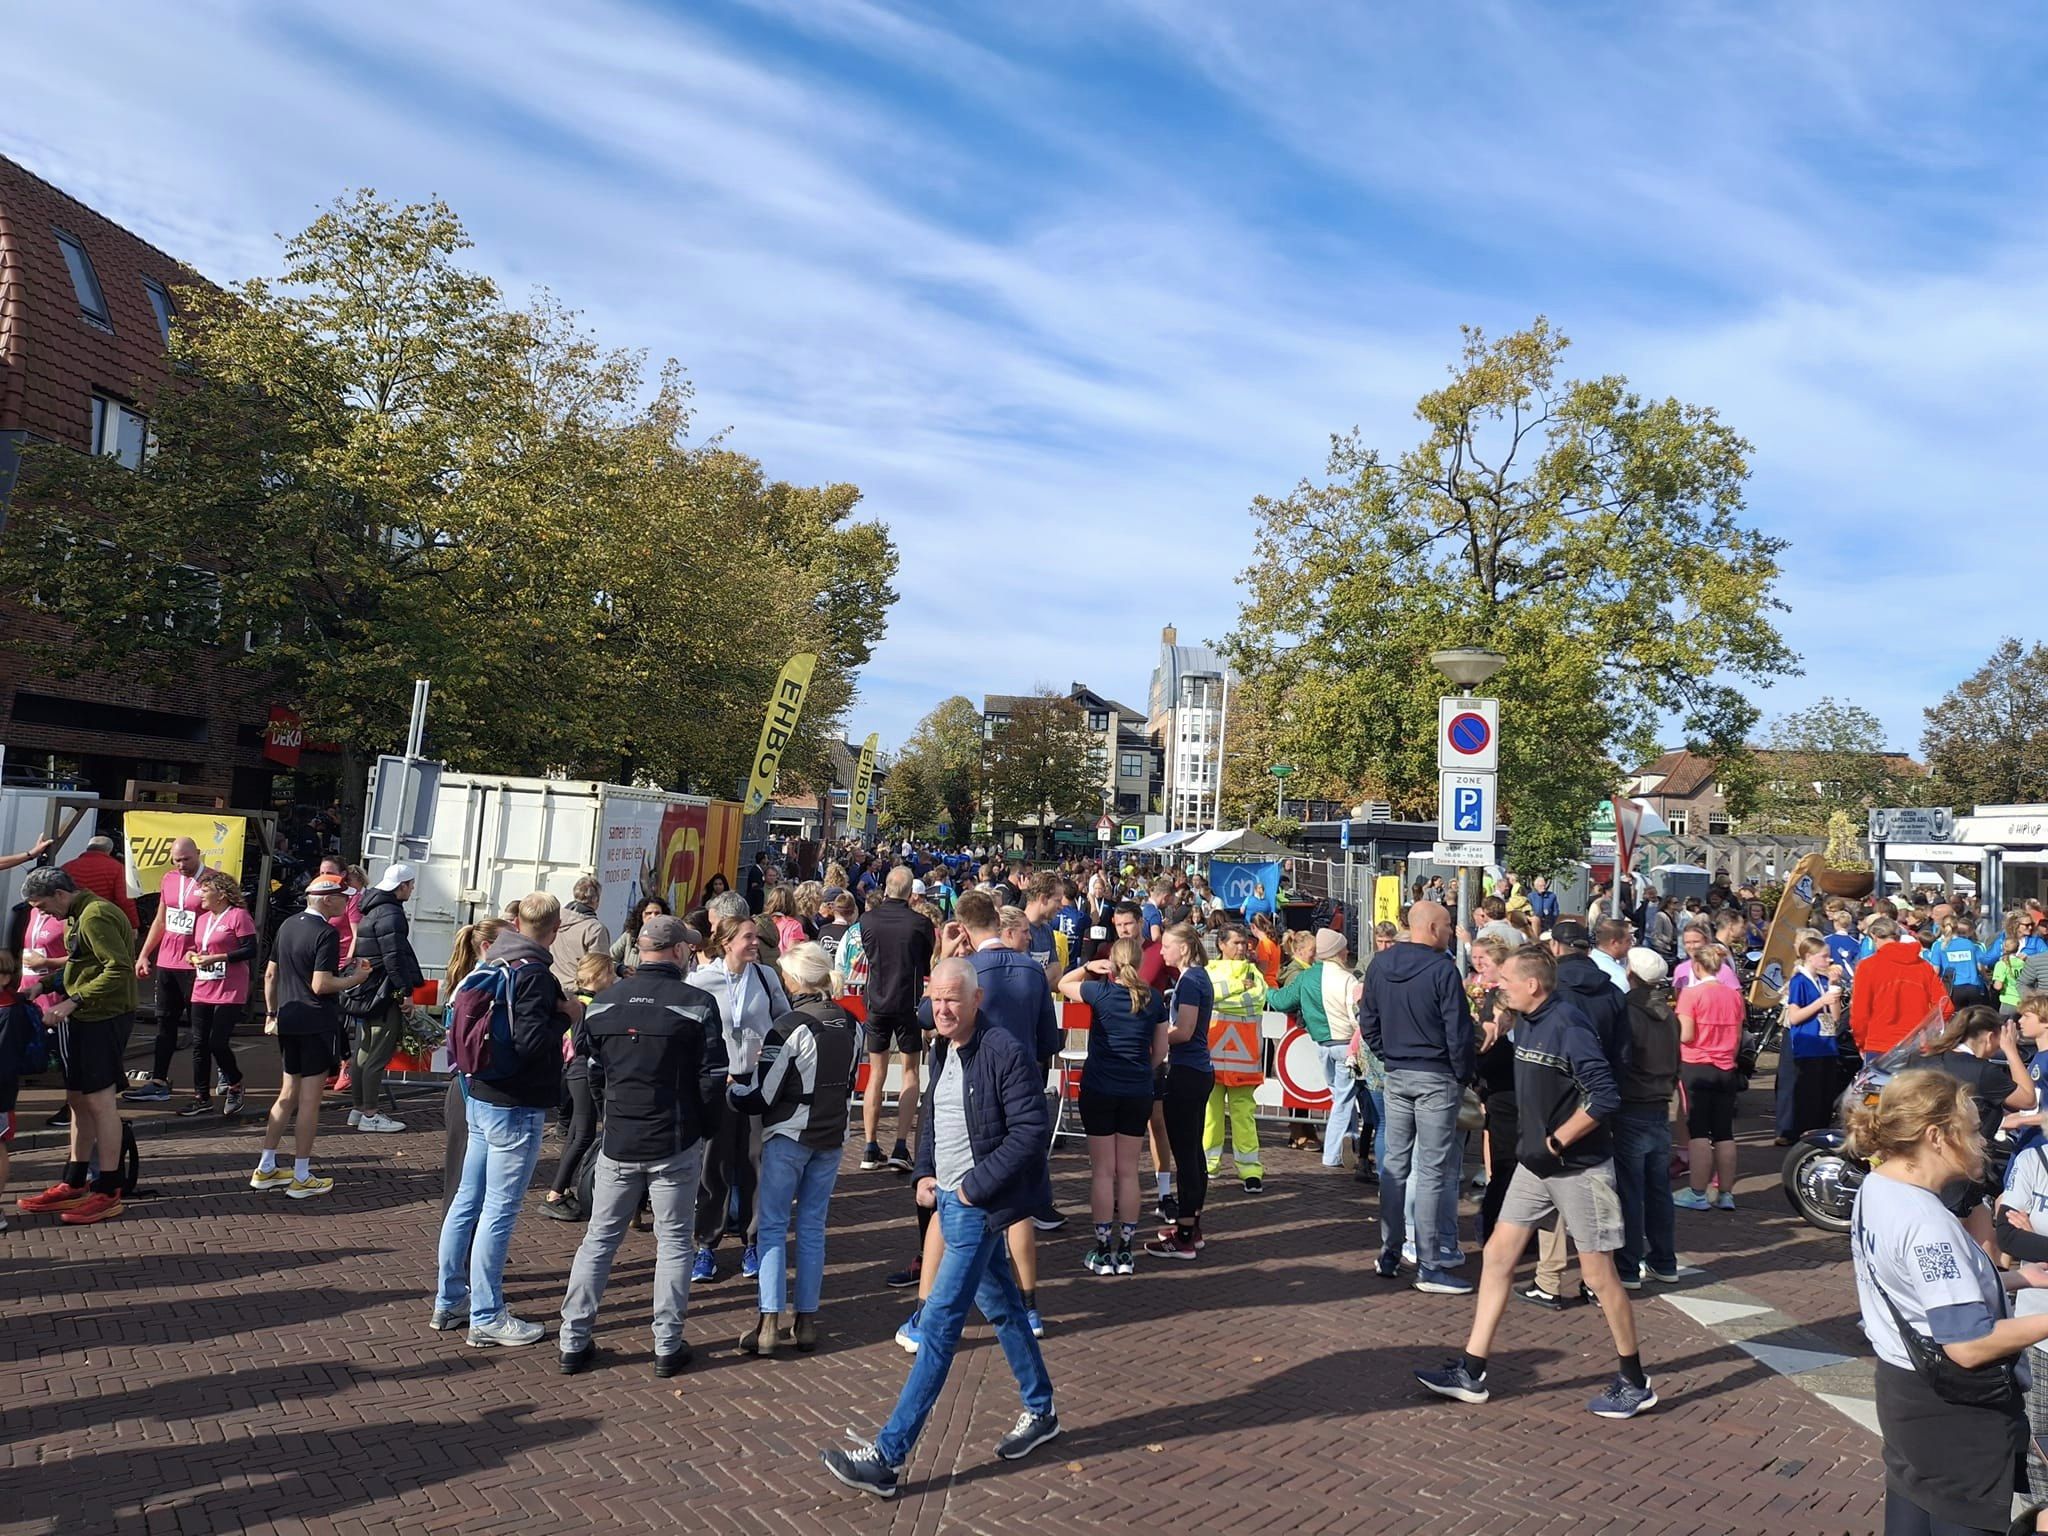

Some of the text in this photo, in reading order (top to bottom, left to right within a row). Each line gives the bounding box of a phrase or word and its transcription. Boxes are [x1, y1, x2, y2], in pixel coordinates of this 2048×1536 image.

[758, 678, 803, 779] EHBO
[855, 749, 873, 806] EHBO
[1456, 776, 1483, 785] ZONE
[1460, 789, 1478, 814] P
[130, 837, 177, 867] EHB
[167, 912, 194, 930] 1402
